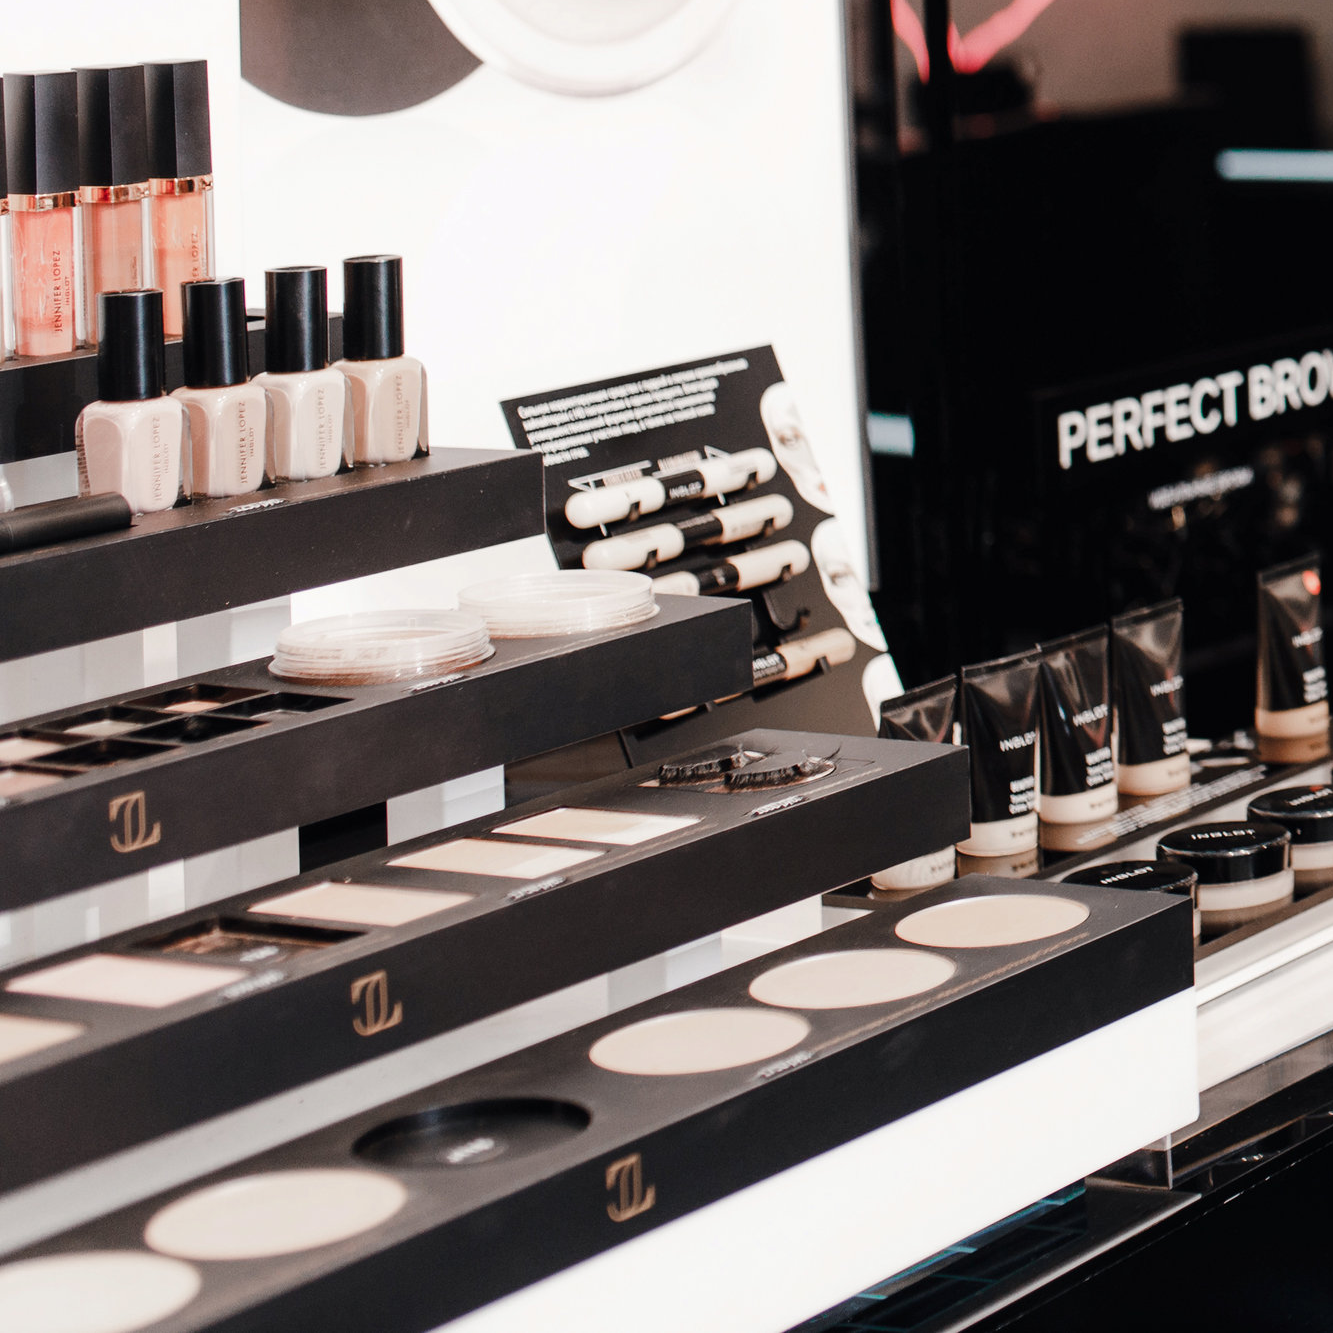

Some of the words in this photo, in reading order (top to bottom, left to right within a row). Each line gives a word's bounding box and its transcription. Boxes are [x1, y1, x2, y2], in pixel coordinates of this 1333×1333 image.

[52, 250, 61, 282] LOPEZ
[52, 284, 63, 333] JENNIFER
[152, 416, 160, 449] LOPEZ
[238, 401, 246, 433] LOPEZ
[1058, 369, 1244, 470] PERFECT
[152, 452, 162, 502] JENNIFER
[239, 436, 248, 484] JENNIFER
